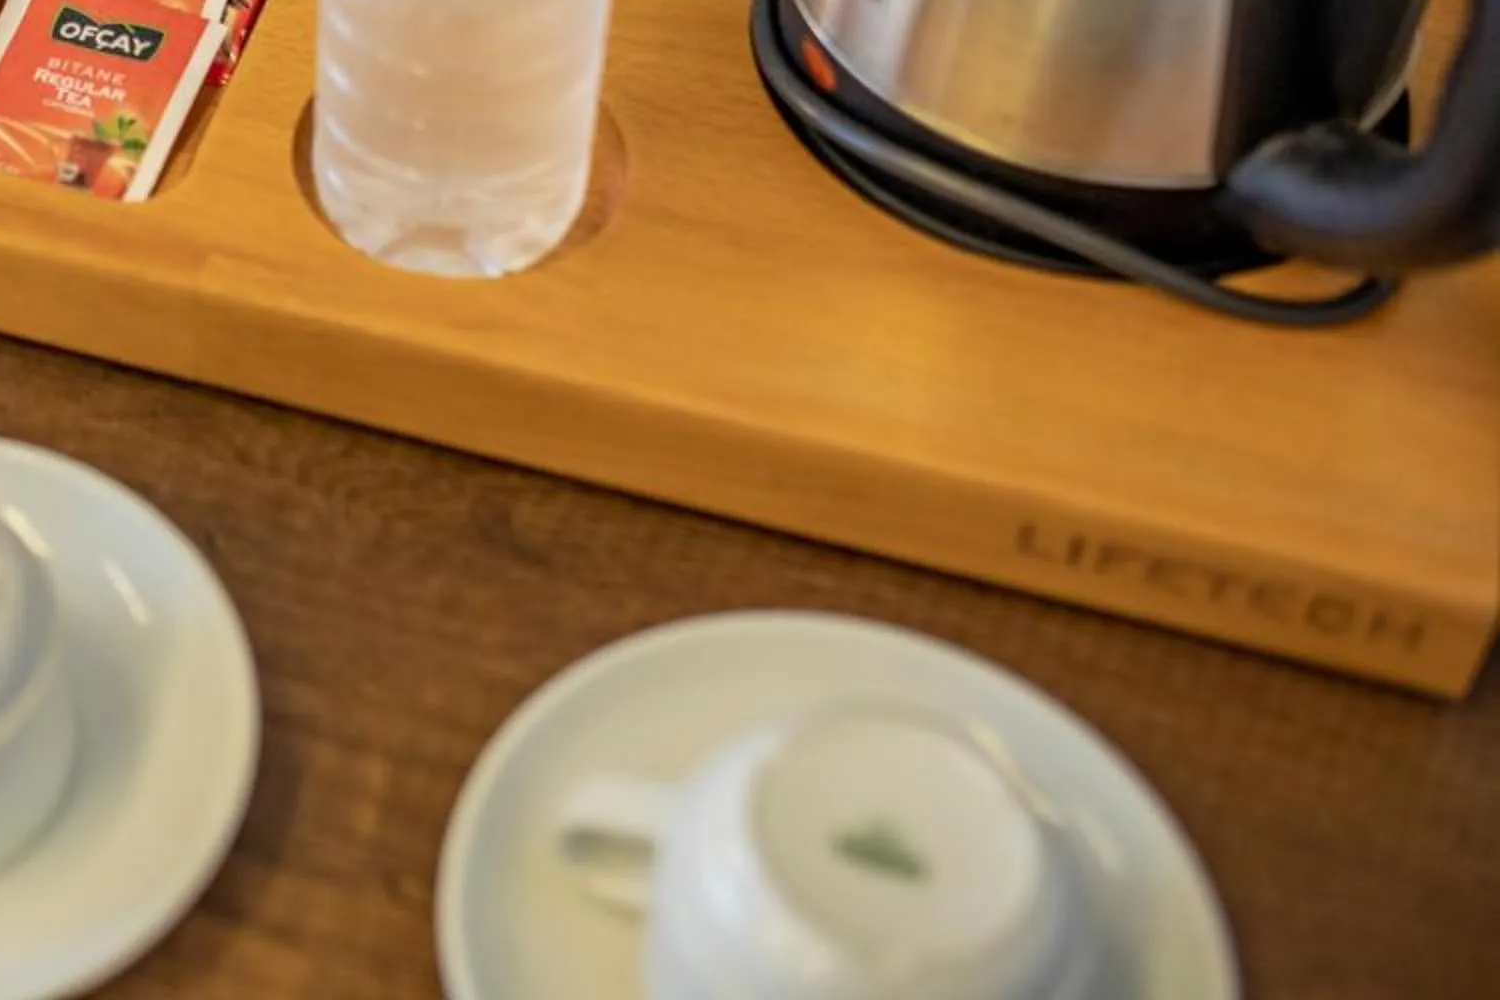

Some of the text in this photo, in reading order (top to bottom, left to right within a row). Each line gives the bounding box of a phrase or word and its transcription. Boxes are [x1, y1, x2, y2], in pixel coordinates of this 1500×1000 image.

[59, 21, 152, 57] OFÇAY
[33, 67, 127, 102] REGULAR
[47, 57, 127, 86] BITANE
[55, 87, 93, 108] TEA
